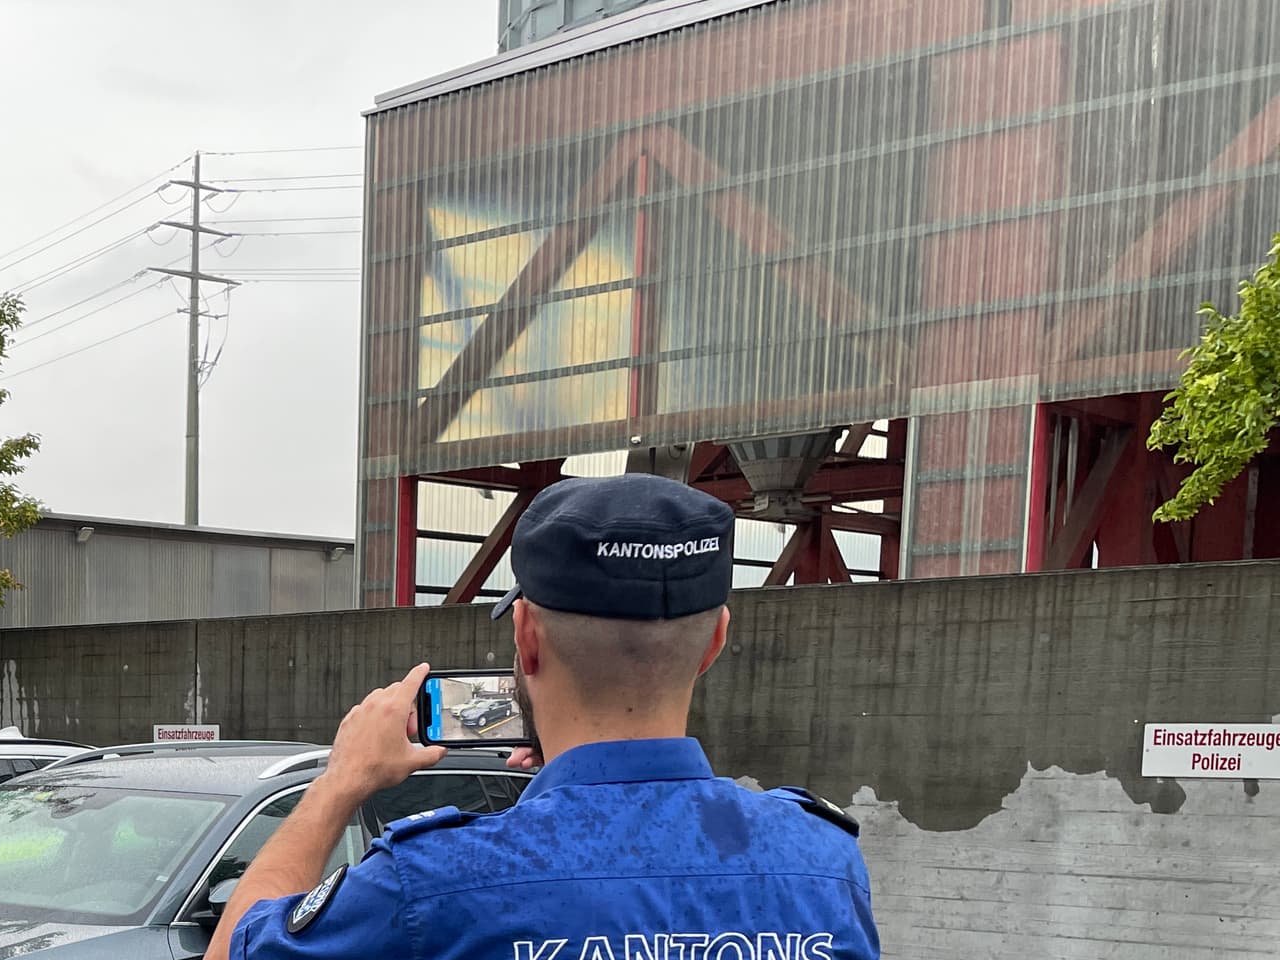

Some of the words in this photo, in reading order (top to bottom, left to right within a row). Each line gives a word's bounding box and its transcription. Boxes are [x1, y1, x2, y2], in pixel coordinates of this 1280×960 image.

[596, 536, 720, 559] KANTONSPOLIZEI
[157, 728, 215, 741] Einsatzfahrzeuge
[1191, 753, 1242, 770] Polizei
